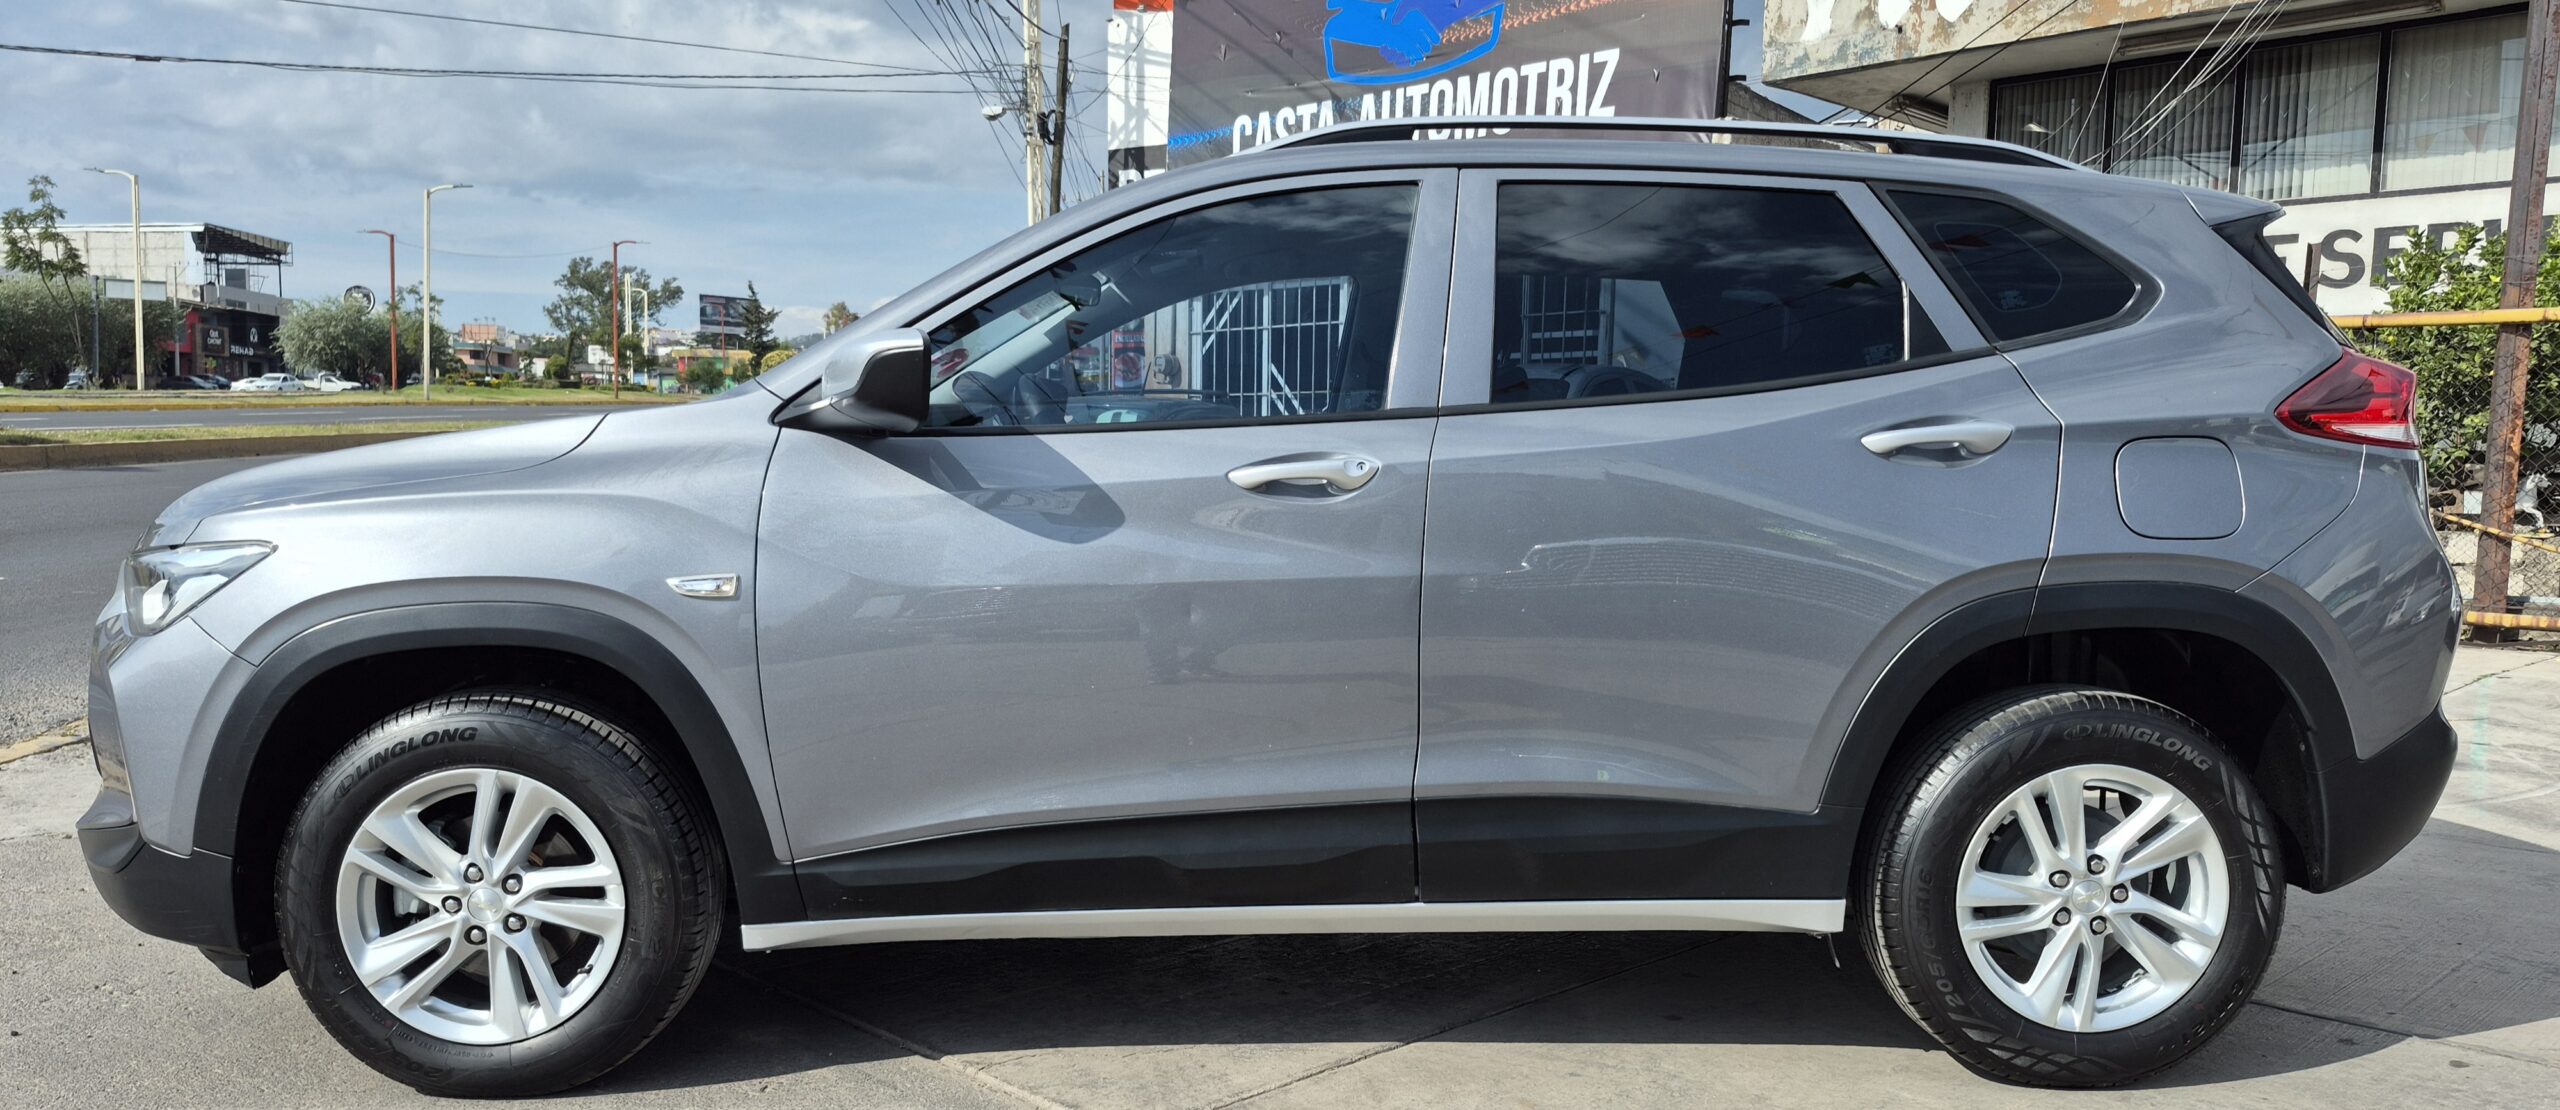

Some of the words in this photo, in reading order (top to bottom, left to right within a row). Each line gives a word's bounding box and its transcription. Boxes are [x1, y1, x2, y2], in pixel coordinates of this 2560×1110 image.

[230, 345, 254, 356] REHAB
[356, 727, 479, 780] LINGLONG
[2094, 723, 2213, 771] LINGLONG
